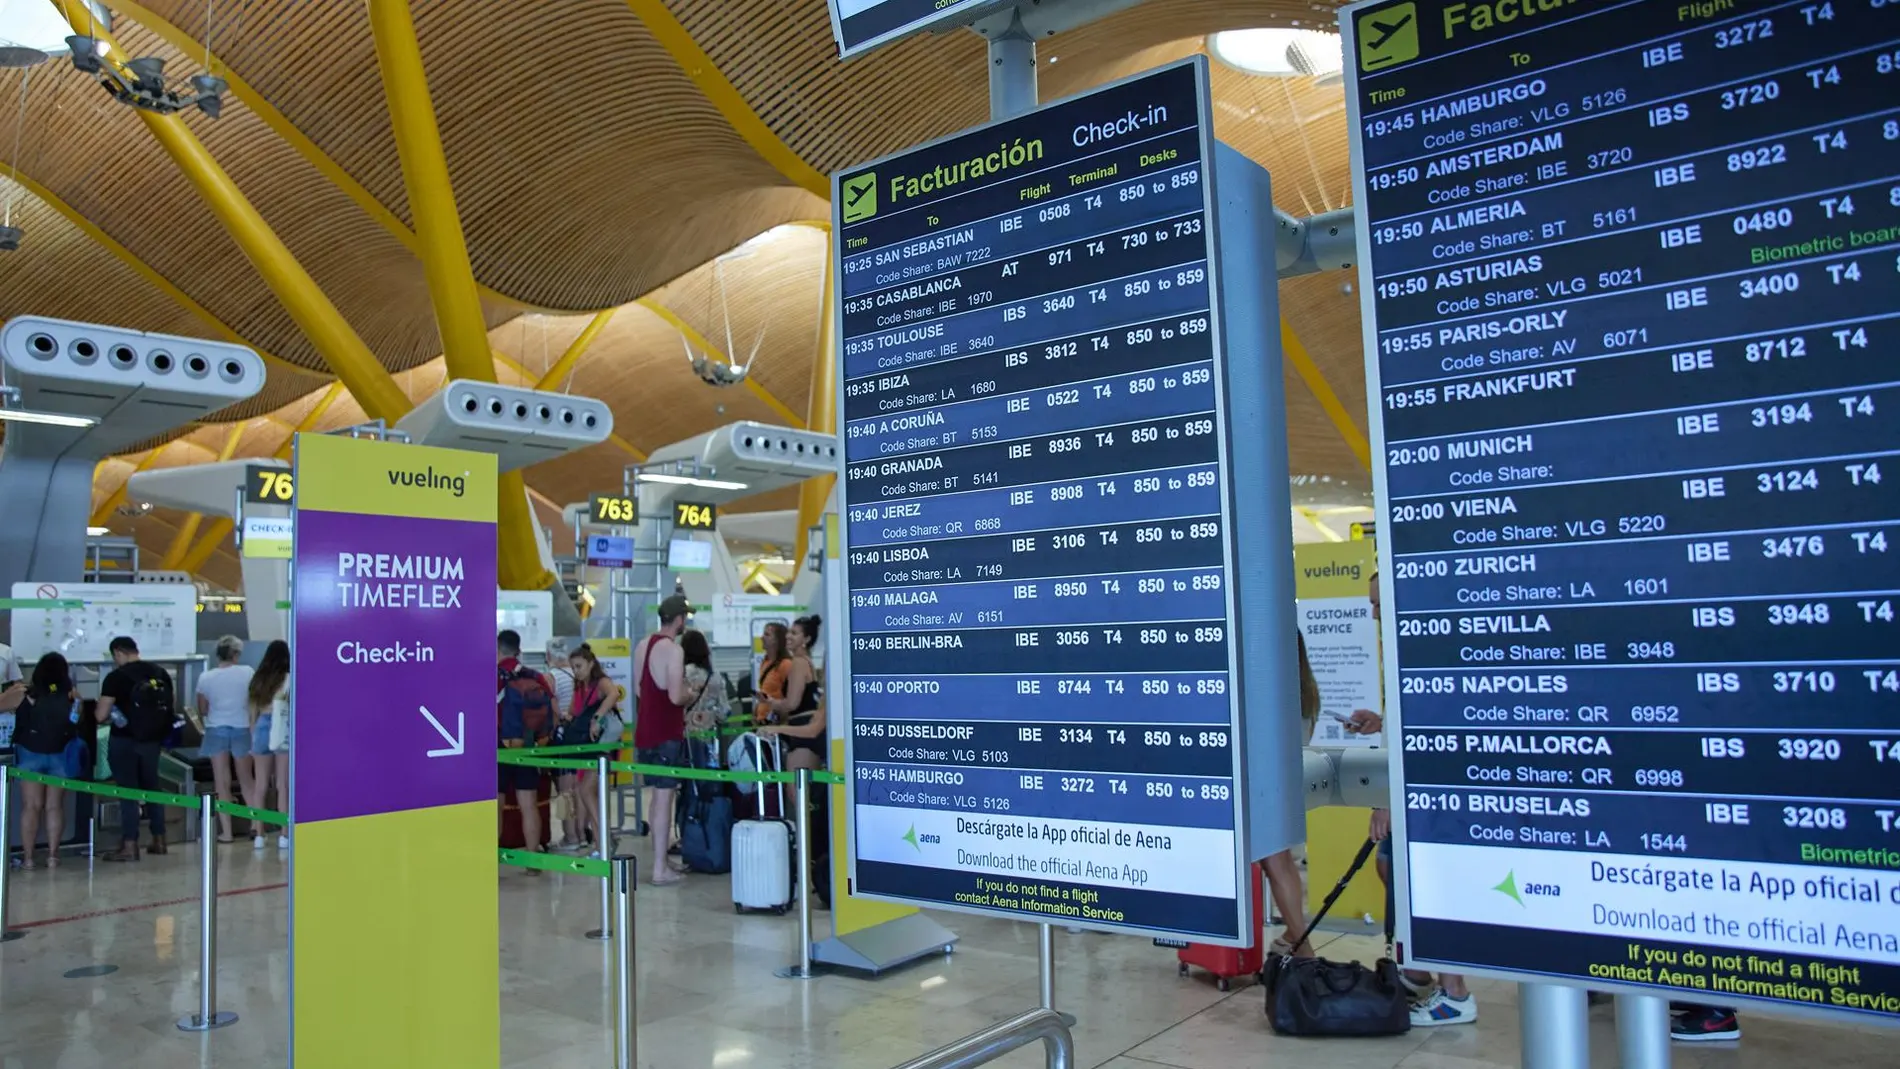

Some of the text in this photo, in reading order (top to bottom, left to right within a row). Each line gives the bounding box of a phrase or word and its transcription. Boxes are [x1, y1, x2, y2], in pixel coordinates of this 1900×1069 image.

[1678, 0, 1734, 21] Flight
[1365, 2, 1834, 138] 19:45 HAMBURGO IBE 3272 T4
[1509, 53, 1530, 66] To
[1369, 88, 1405, 104] Time
[1073, 105, 1167, 146] Check-in
[1423, 88, 1626, 149] Code Share: VLG 5126
[889, 136, 1046, 203] Facturación
[1020, 149, 1177, 200] Flight Terminal Desks
[844, 170, 1198, 274] 19:25 SAN SEBASTIAN IBE 0508 T4 850 to 859
[927, 216, 939, 226] To
[846, 237, 868, 248] Time
[1378, 196, 1854, 299] 19:50 ASTURIAS IBE 0480 T4
[1751, 238, 1843, 263] Biometric
[876, 247, 990, 284] Code Share: BAW 7222
[1437, 267, 1641, 314] Code Share: VLG 5021
[848, 420, 1212, 480] 19:40 GRANADA IBE 8936 T4 850 to 859
[260, 472, 293, 499] 76
[388, 466, 464, 497] vueling
[881, 472, 998, 496] Code Share: BT 5141
[1393, 463, 1881, 522] 20:00 VIENA IBE 3124 T4
[598, 498, 633, 520] 763
[679, 505, 711, 526] 764
[1453, 515, 1665, 544] Code Share: VLG 5220
[337, 551, 464, 581] PREMIUM
[1304, 561, 1360, 580] vueling
[337, 582, 463, 609] TIMEFLEX
[1306, 608, 1367, 620] CUSTOMER
[1399, 600, 1893, 636] 20:00 SEVILLA IBS 3948 T4
[853, 627, 1223, 650] 19:40 BERLIN-BRA IBE 3056 T4 850 to 859
[1307, 623, 1352, 634] SERVICE
[337, 641, 433, 664] Check-in
[1460, 642, 1674, 661] Code Share: IBE 3948
[856, 767, 1229, 800] 19:45 HAMBURGO IBE 3272 T4 850 to 859
[890, 791, 1010, 810] Code Share: VLG 5126
[920, 834, 940, 844] aena
[957, 817, 1171, 850] Descárgate la App oficial de Aena
[957, 848, 1148, 886] Download the official Aena App
[977, 878, 1098, 904] If you do not find a flight
[1525, 883, 1560, 896] aena
[1591, 861, 1713, 892] Descárgate
[1722, 869, 1740, 892] la
[1750, 871, 1795, 901] App
[1804, 875, 1880, 902] oficial
[955, 893, 1123, 921] contact Aena Information Service
[1593, 903, 1898, 953] Download the official Aena
[1629, 944, 1860, 984] If you do not find a flight
[1589, 963, 1653, 983] contact
[1658, 968, 1706, 988] Aena
[1712, 973, 1824, 1002] Information
